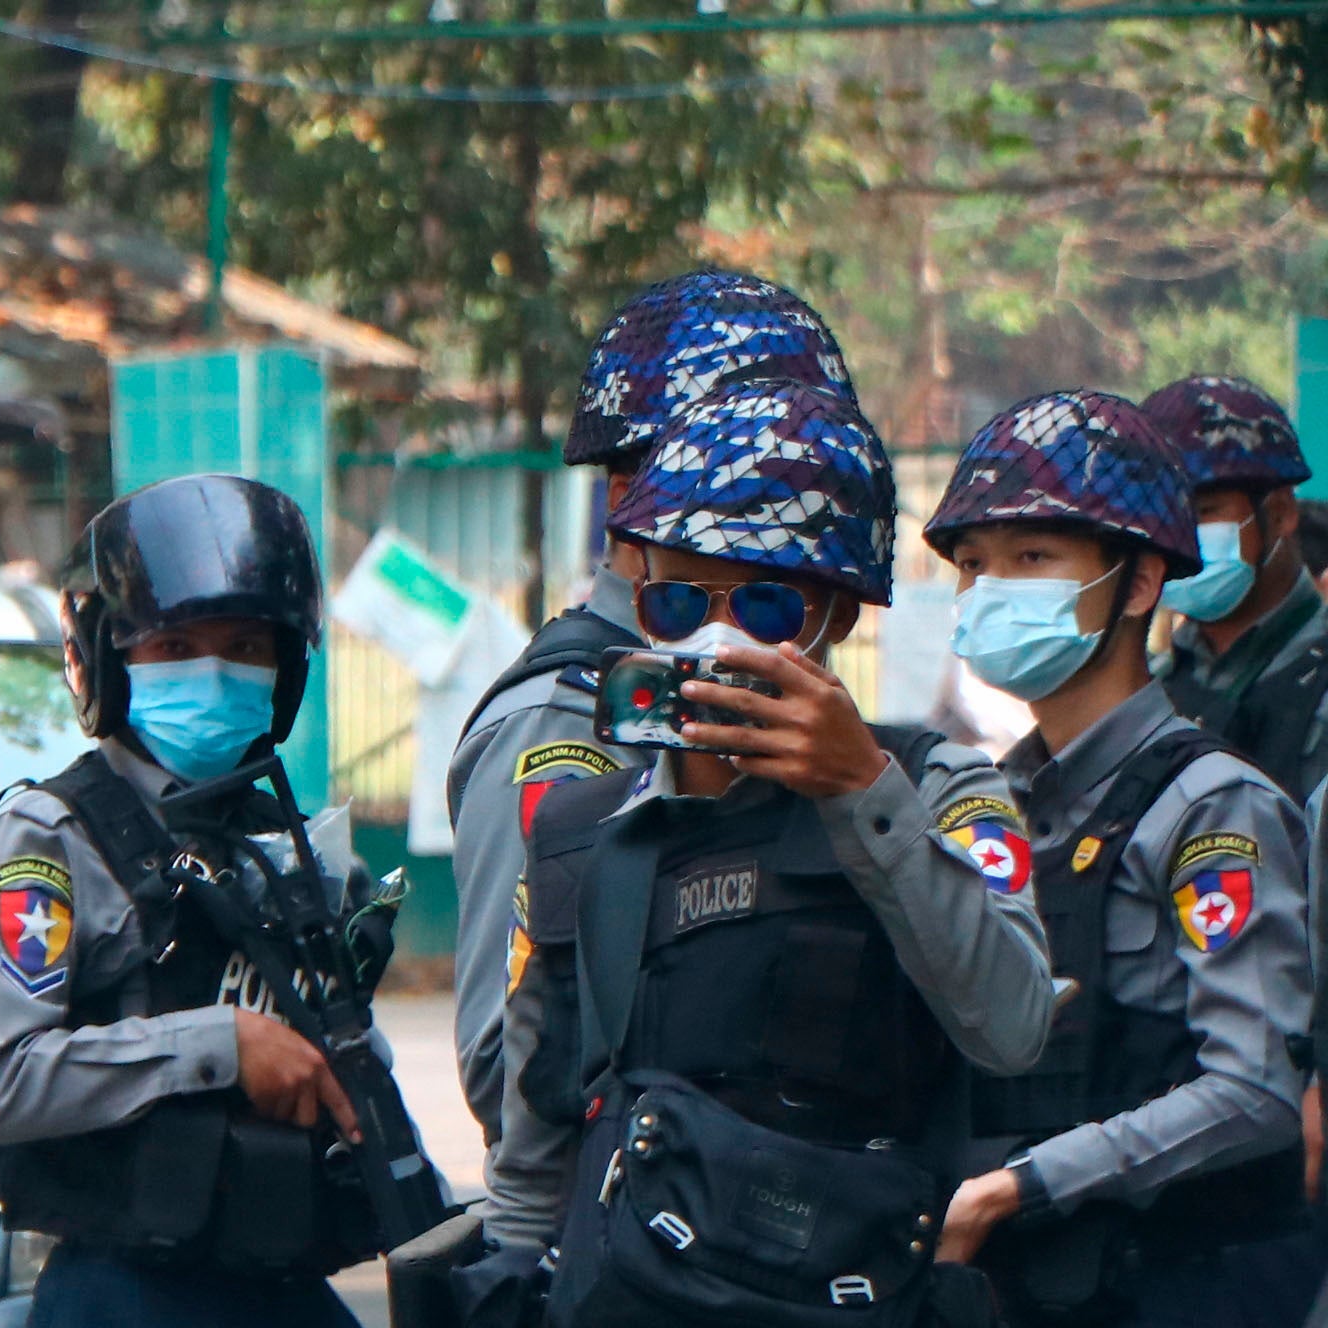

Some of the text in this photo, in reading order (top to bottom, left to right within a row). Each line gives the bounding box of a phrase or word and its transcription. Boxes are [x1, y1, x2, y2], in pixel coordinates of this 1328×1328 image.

[529, 747, 616, 774] MYANMAR POLIC
[677, 870, 754, 926] POLICE
[749, 1184, 811, 1217] TOUGH
